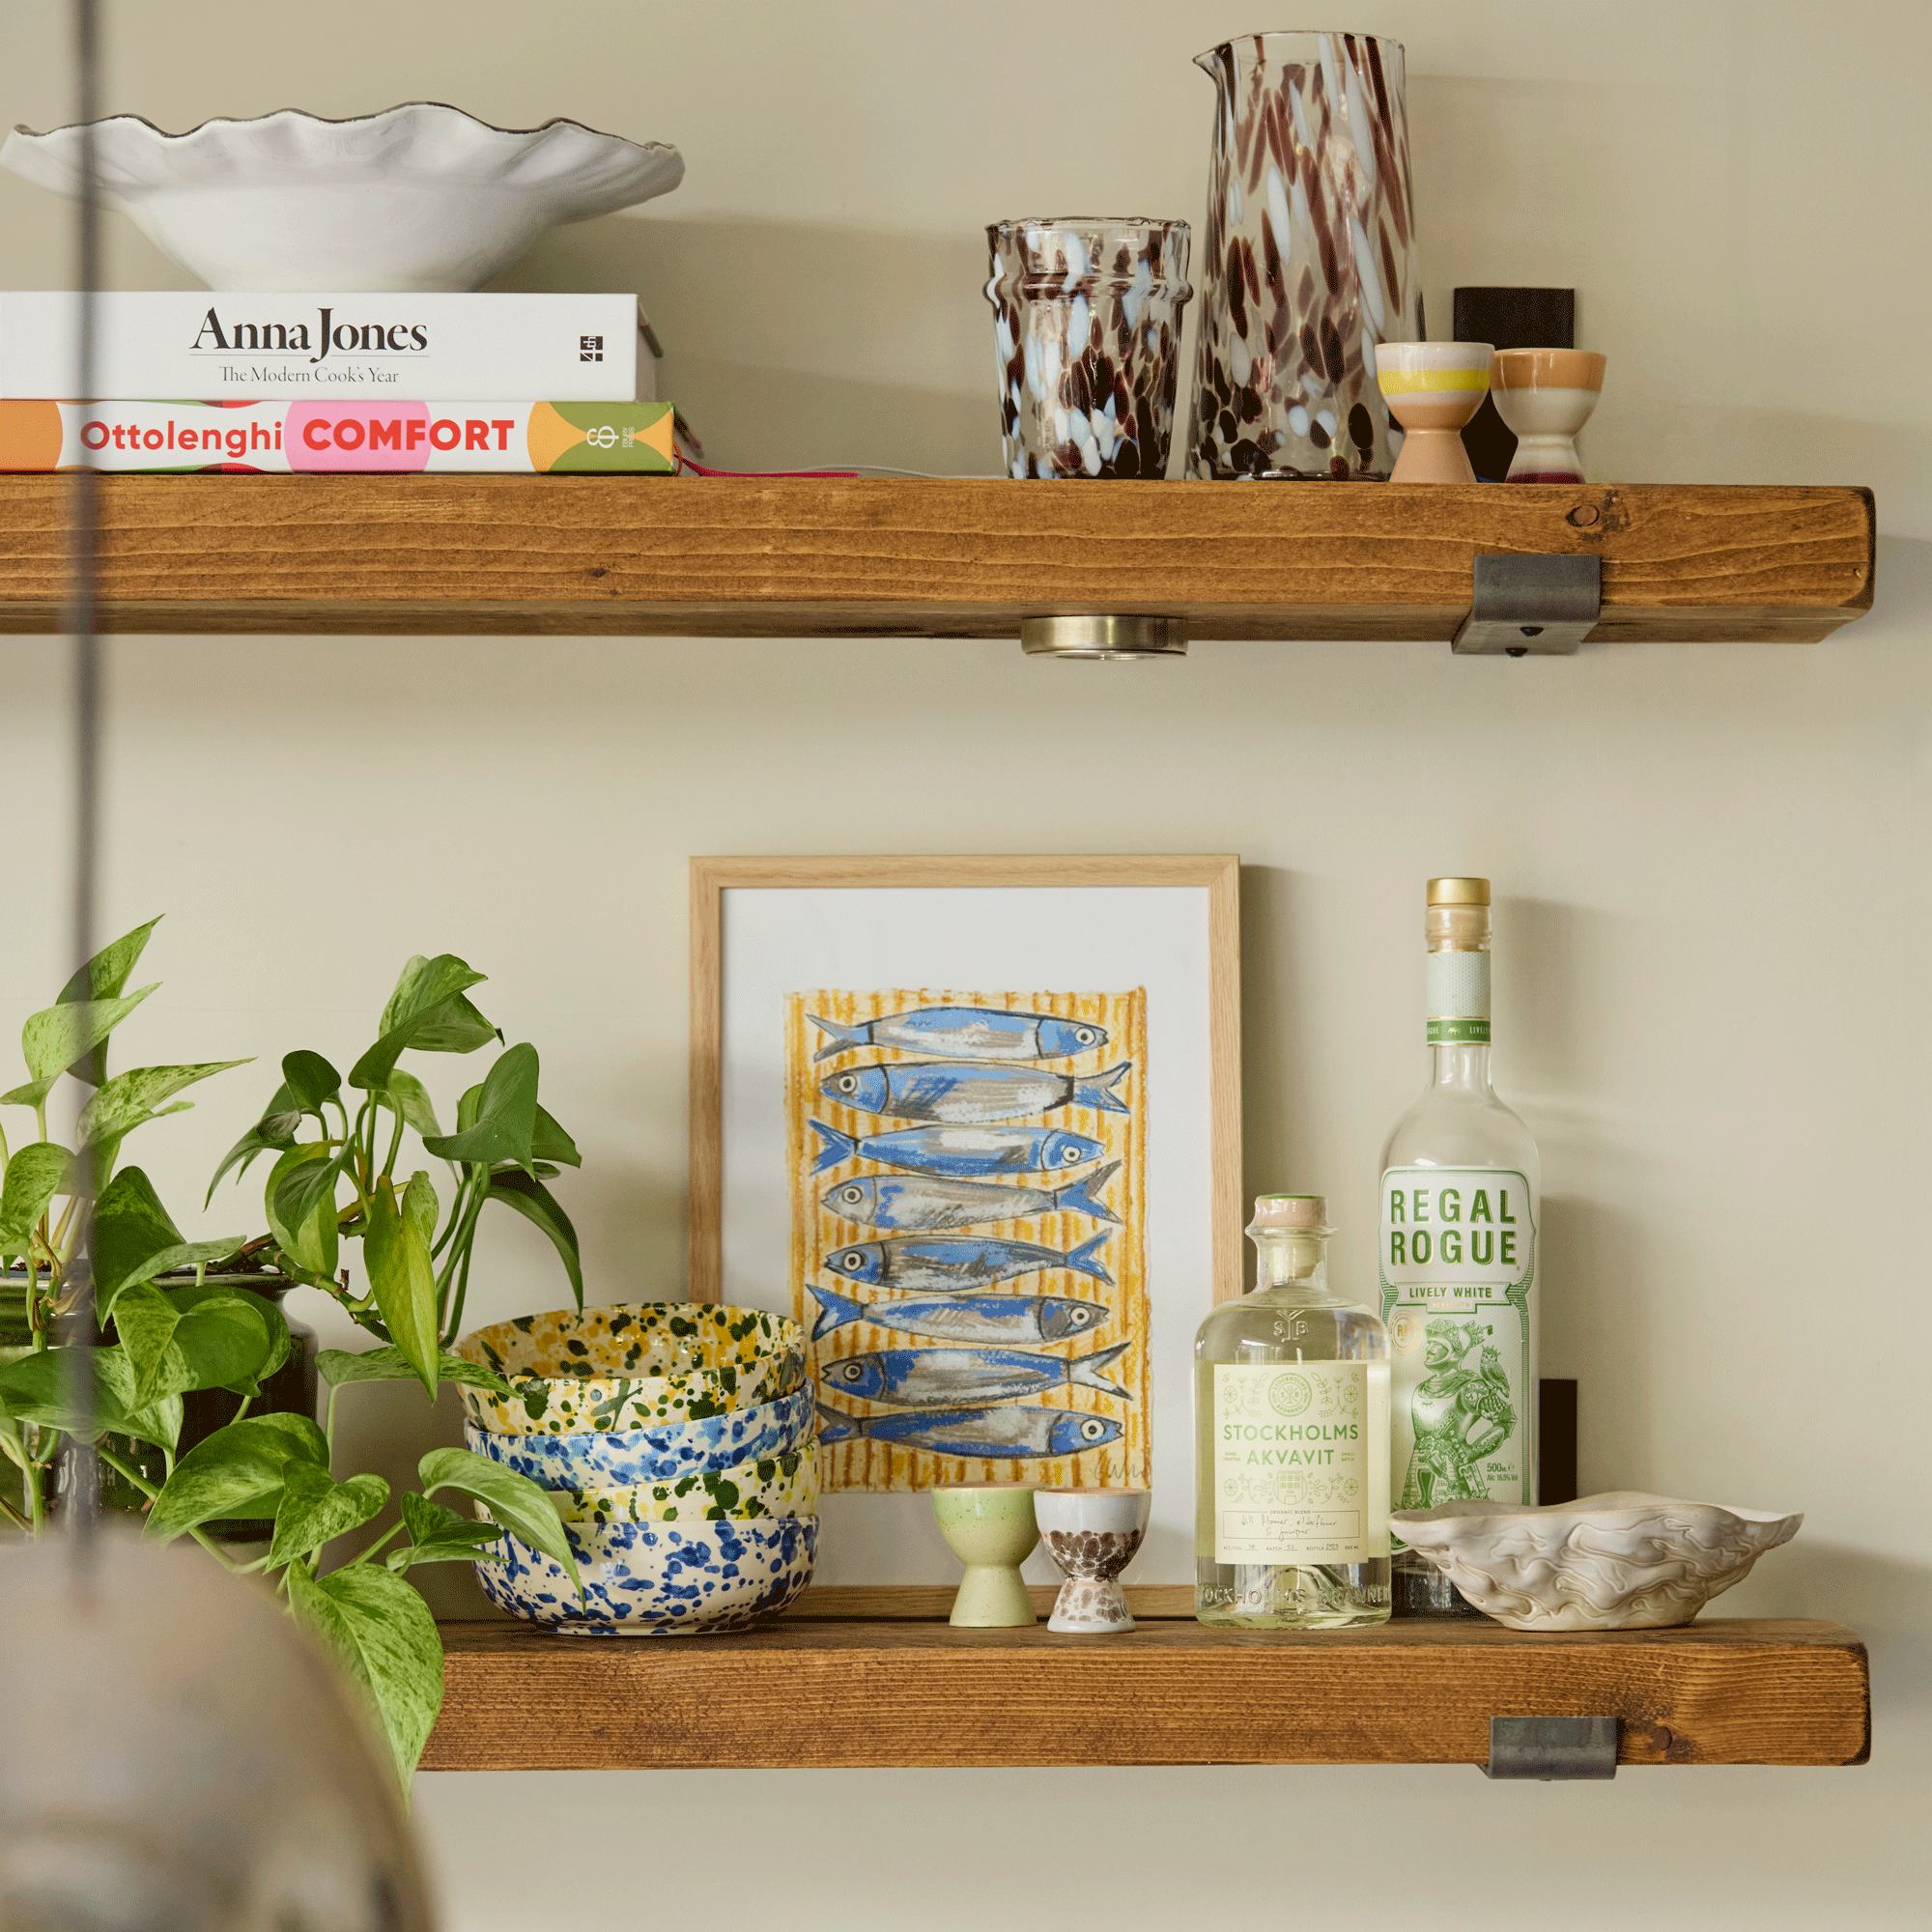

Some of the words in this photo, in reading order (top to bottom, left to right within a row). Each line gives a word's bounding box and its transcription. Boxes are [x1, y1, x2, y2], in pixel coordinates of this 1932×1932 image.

[189, 306, 312, 350] Anna
[309, 307, 428, 363] Jones
[218, 365, 247, 382] The
[250, 365, 311, 382] Modern
[367, 367, 399, 383] Year
[80, 420, 282, 458] Ottolenghi
[302, 418, 515, 451] COMFORT
[1390, 1188, 1517, 1224] REGAL
[1390, 1230, 1518, 1265] ROGUE
[1409, 1287, 1448, 1298] LIVELY
[1453, 1287, 1492, 1298] WHITE
[1223, 1424, 1359, 1441] STOCKHOLMS
[1246, 1449, 1335, 1465] AKVAVIT
